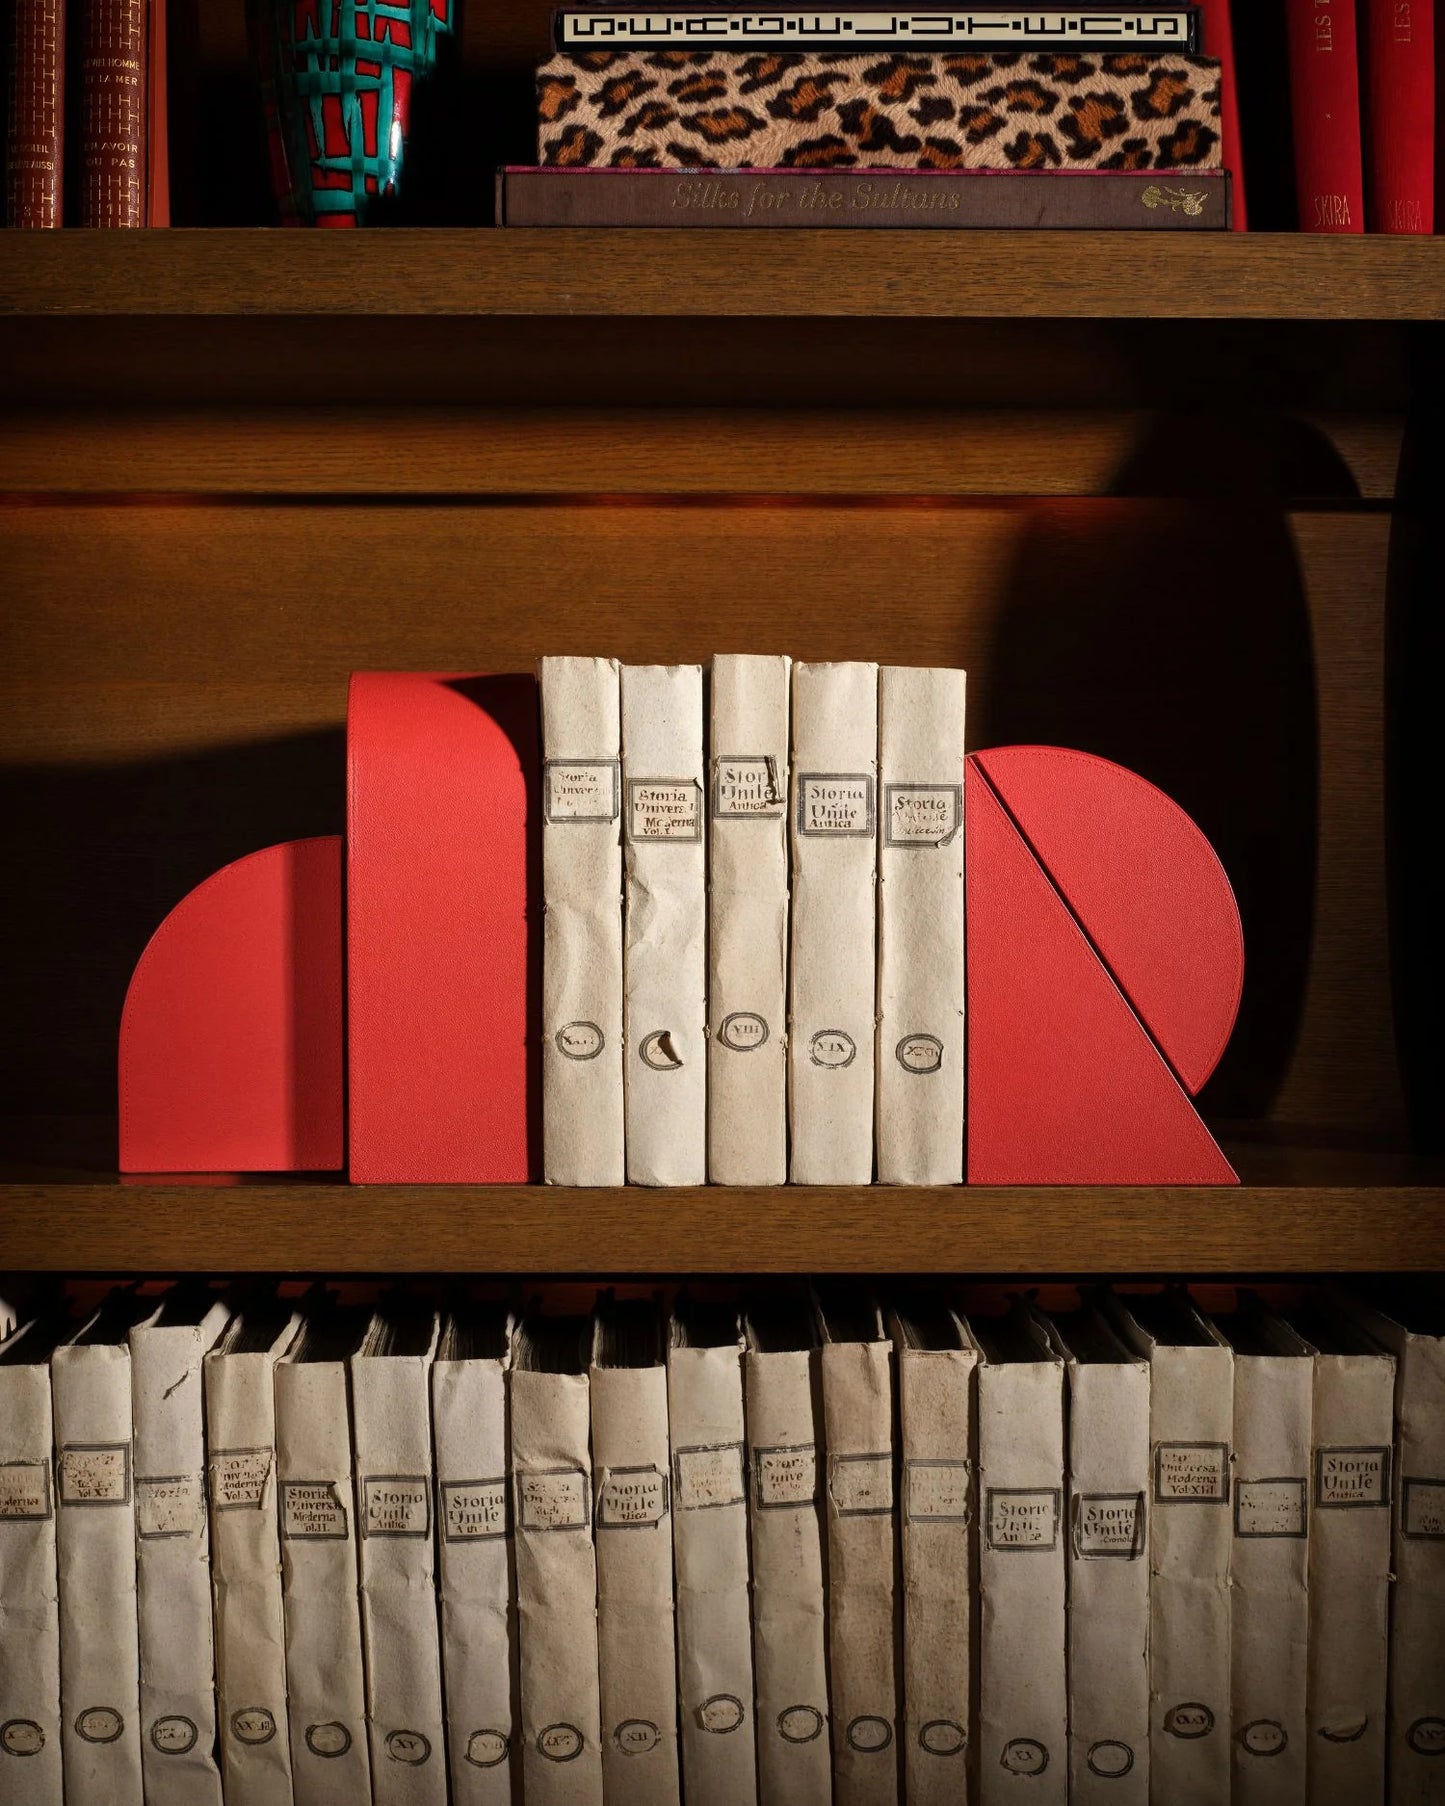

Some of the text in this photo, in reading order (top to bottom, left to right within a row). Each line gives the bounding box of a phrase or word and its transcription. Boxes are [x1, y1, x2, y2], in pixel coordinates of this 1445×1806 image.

[1394, 1, 1412, 43] LES
[1315, 14, 1333, 52] LES
[108, 57, 140, 71] HOMME
[115, 75, 138, 86] MER
[101, 142, 138, 153] AVOIR
[111, 157, 136, 169] PAS
[671, 181, 961, 218] Silks for the Sultans
[1315, 194, 1353, 227] SKIRA
[643, 788, 688, 802] Storia
[811, 785, 864, 800] Storia
[895, 796, 946, 811] Storia
[1328, 1458, 1379, 1472] Storia
[289, 1487, 330, 1500] Storia
[452, 1491, 504, 1509] Storia
